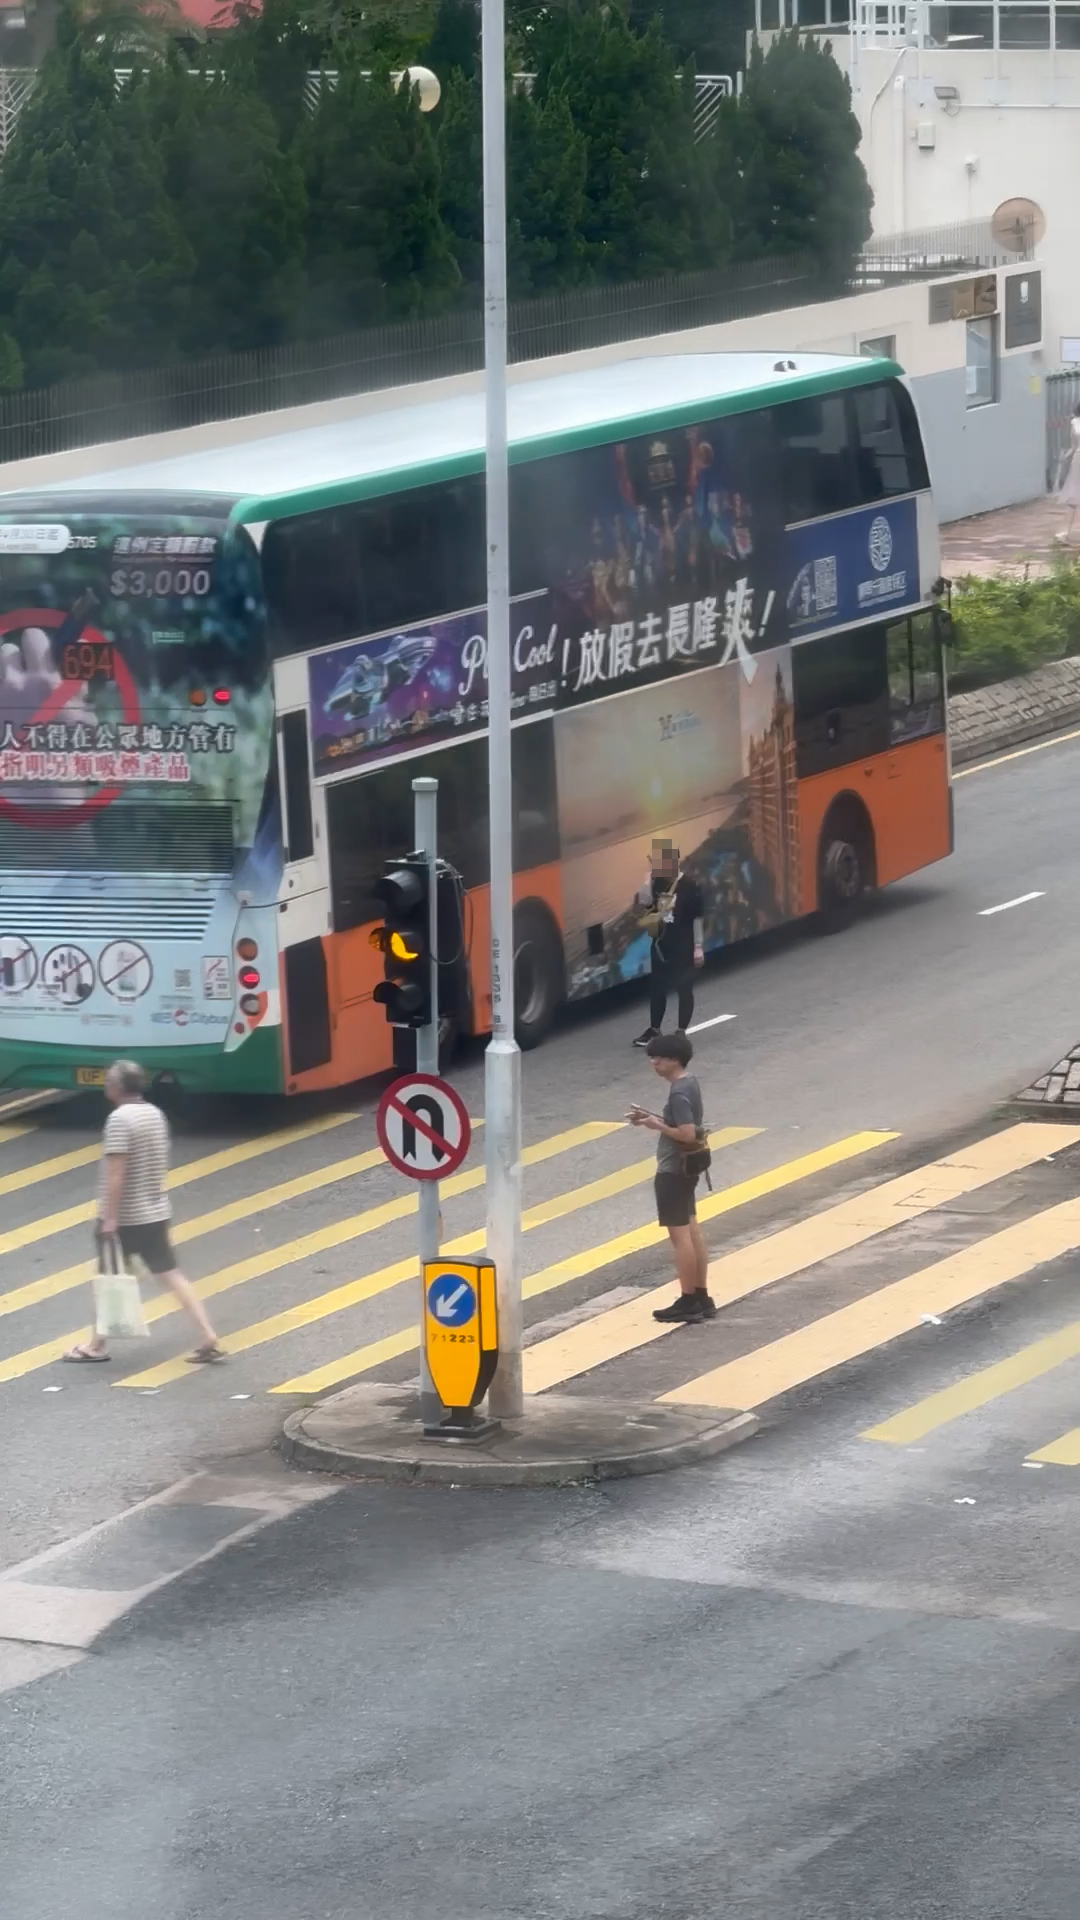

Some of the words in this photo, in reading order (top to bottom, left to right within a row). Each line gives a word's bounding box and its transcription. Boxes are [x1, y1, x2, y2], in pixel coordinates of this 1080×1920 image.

[68, 536, 97, 549] 5705
[110, 569, 211, 598] $3,000
[65, 645, 113, 680] 694
[0, 723, 236, 751] 人不得在公眾地方管有
